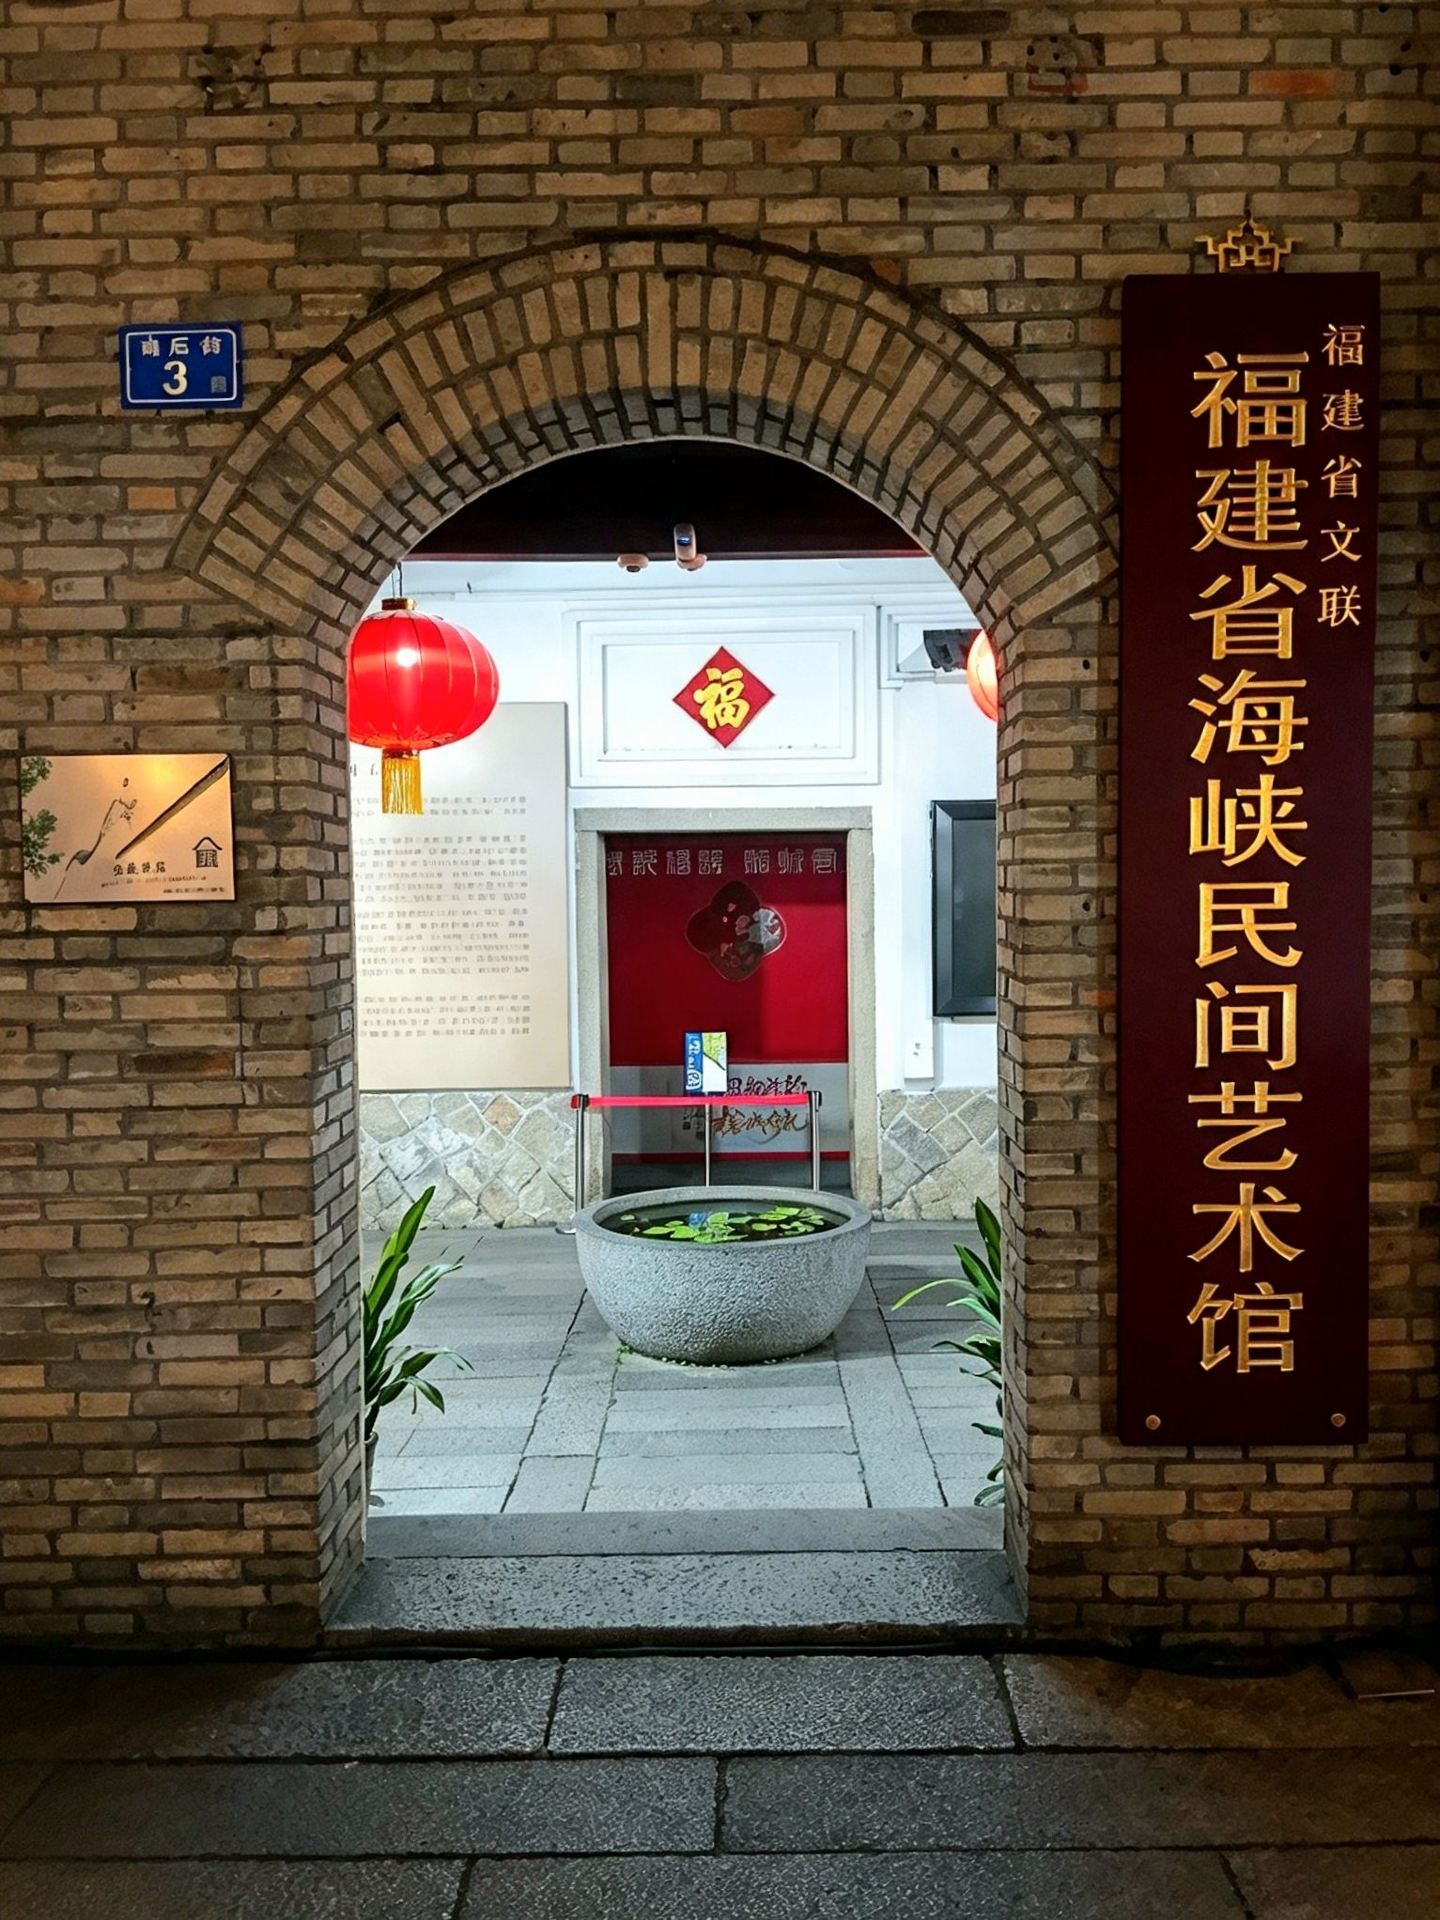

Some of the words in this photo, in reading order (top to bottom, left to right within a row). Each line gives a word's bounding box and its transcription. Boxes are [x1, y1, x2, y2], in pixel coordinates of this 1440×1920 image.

[162, 360, 188, 395] 3
[1317, 323, 1366, 628] 福建省文联
[693, 667, 750, 729] 福
[1187, 351, 1311, 1374] 福建省海峡民间艺术馆
